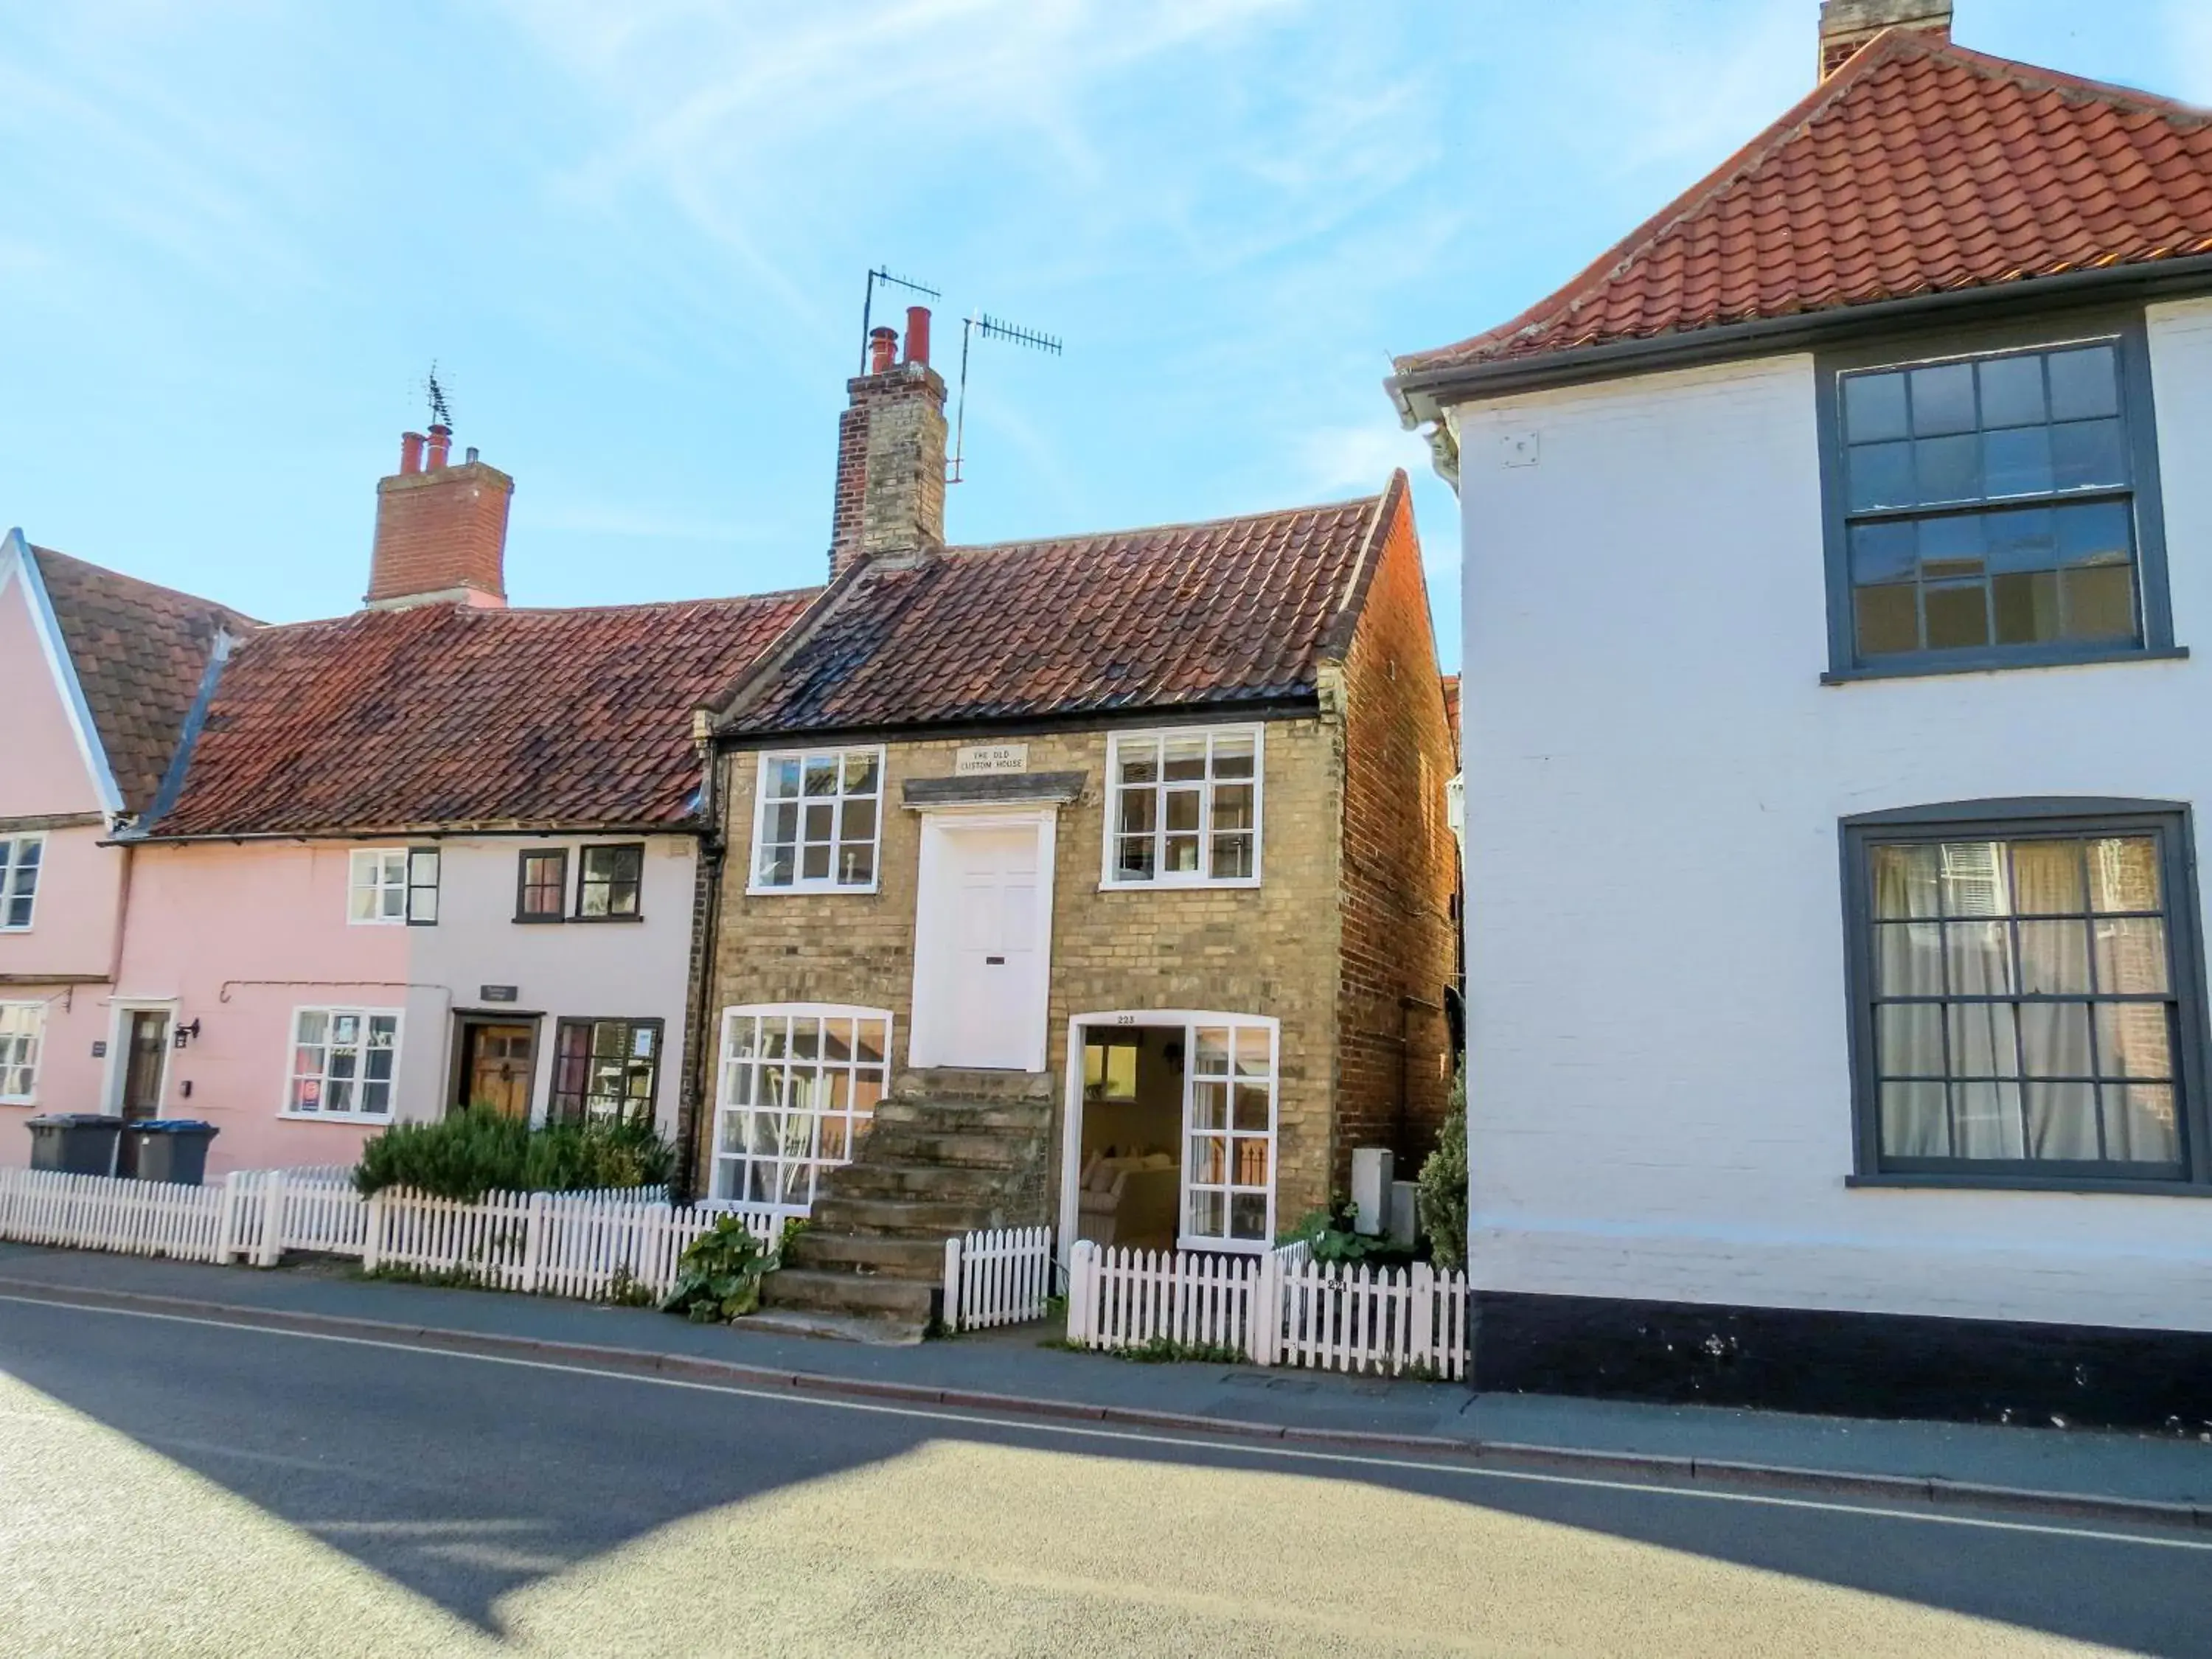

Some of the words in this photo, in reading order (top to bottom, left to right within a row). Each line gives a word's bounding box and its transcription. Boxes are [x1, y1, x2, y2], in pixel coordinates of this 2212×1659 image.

[973, 751, 988, 759] THE
[993, 750, 1009, 759] OLD
[961, 760, 992, 771] CUSTOM
[996, 759, 1023, 768] HOUSE
[1117, 1015, 1135, 1025] 223
